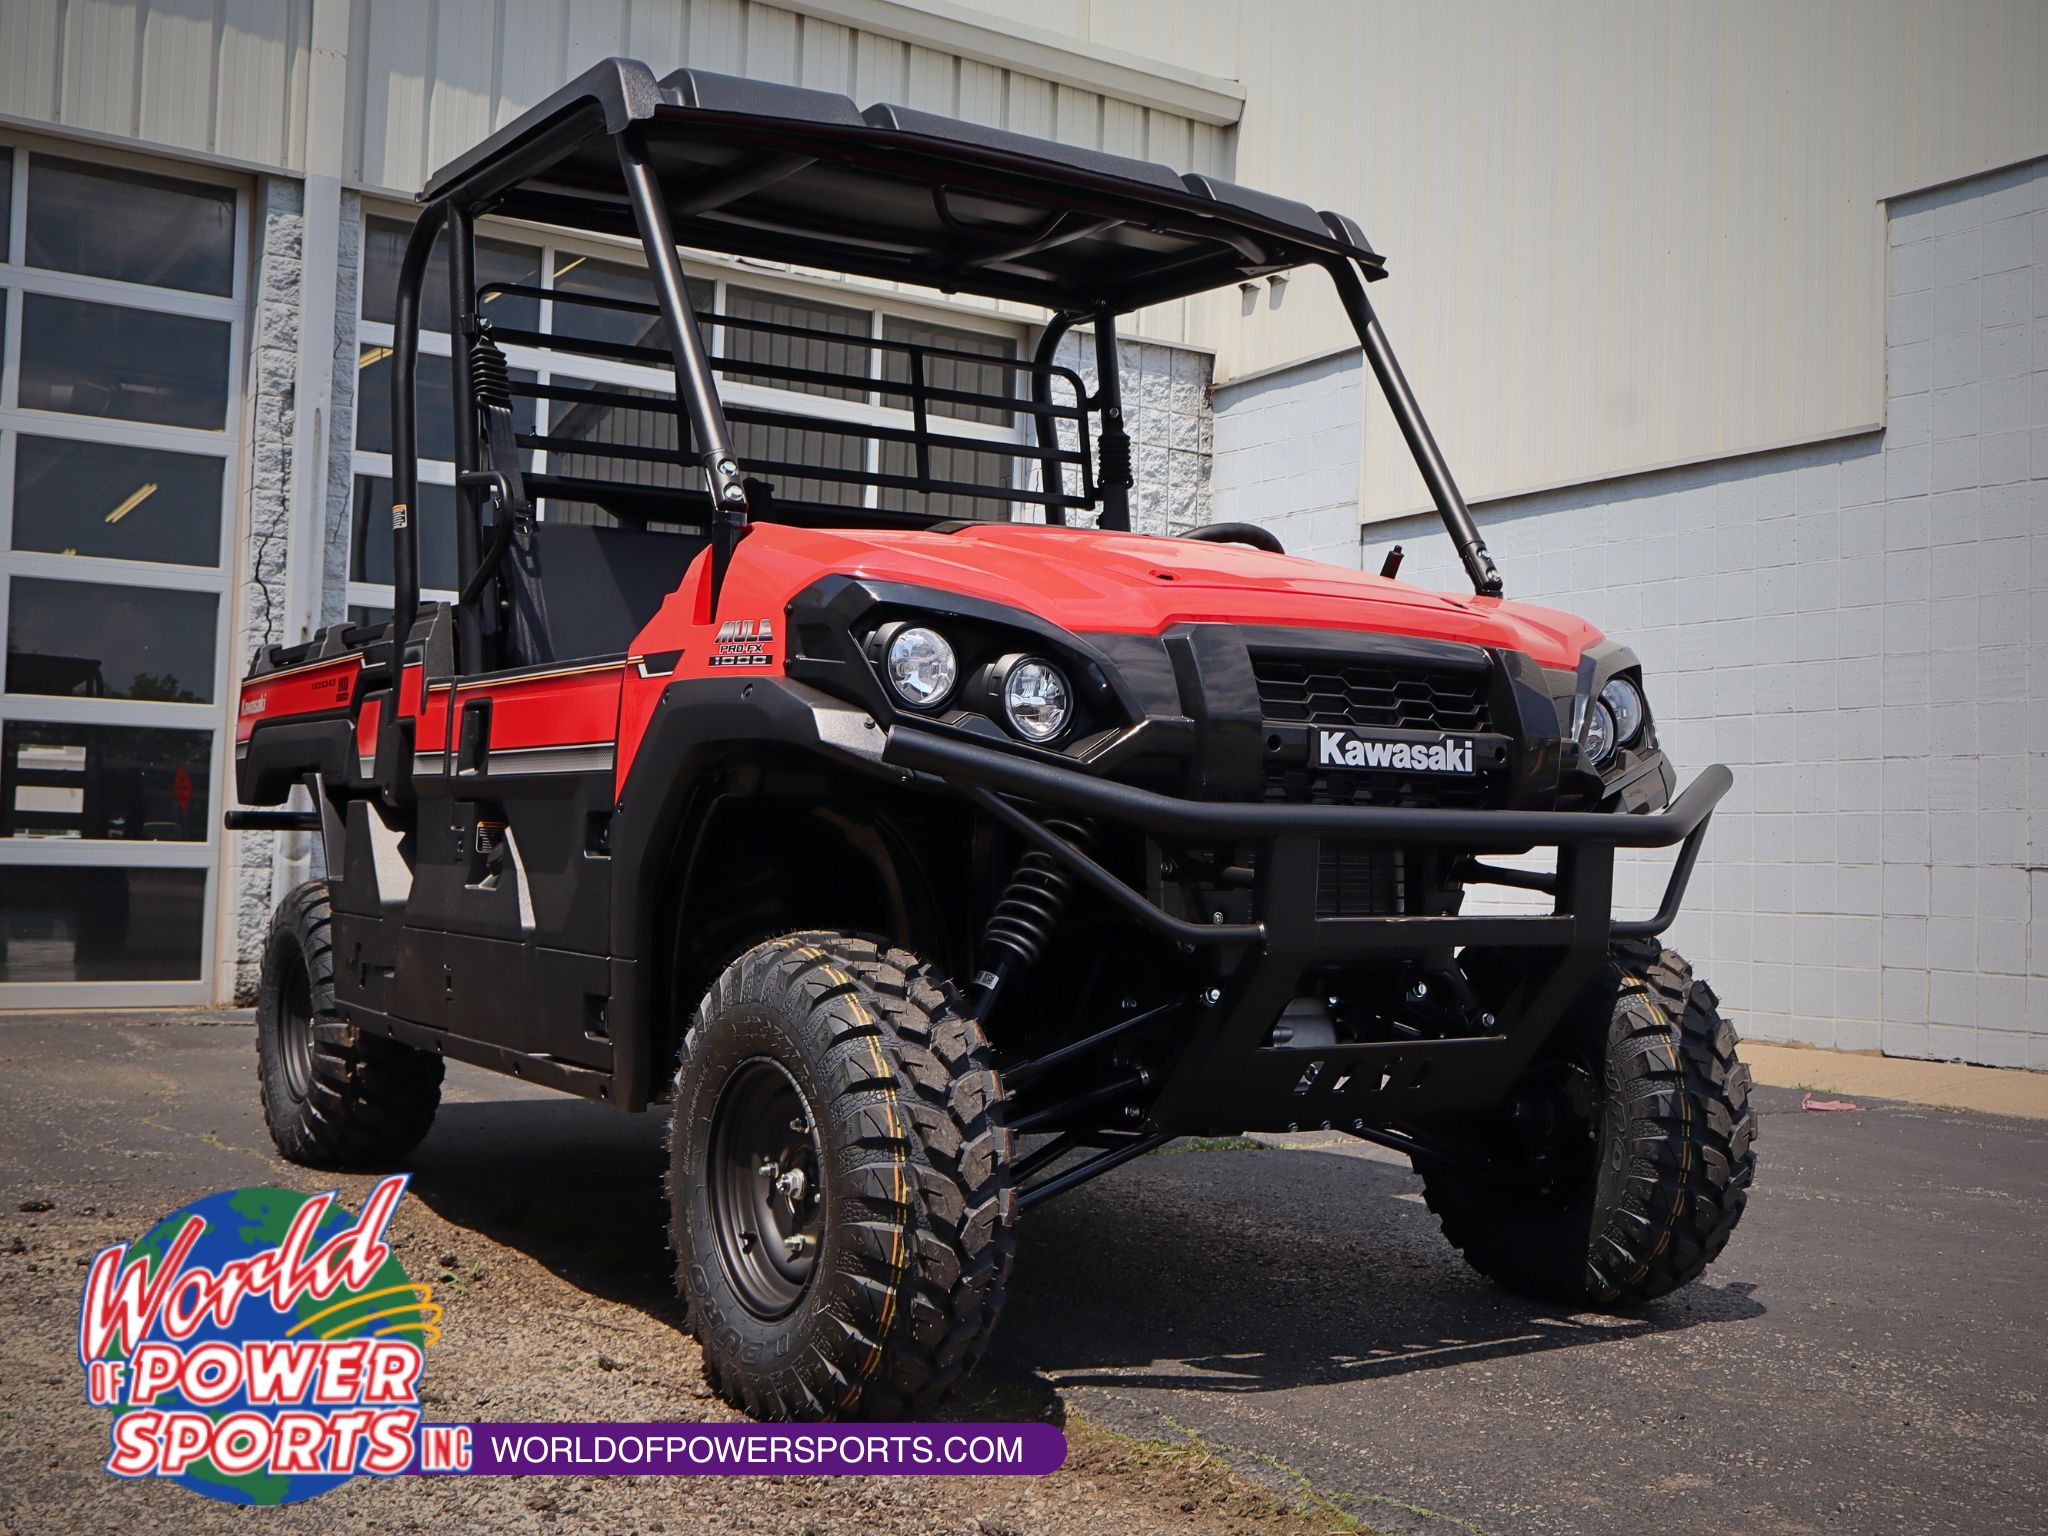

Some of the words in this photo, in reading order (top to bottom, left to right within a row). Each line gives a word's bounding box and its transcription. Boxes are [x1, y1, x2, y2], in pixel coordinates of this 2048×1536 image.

[715, 618, 773, 643] MULE
[714, 655, 768, 665] 1000
[1320, 731, 1473, 772] Kawasaki
